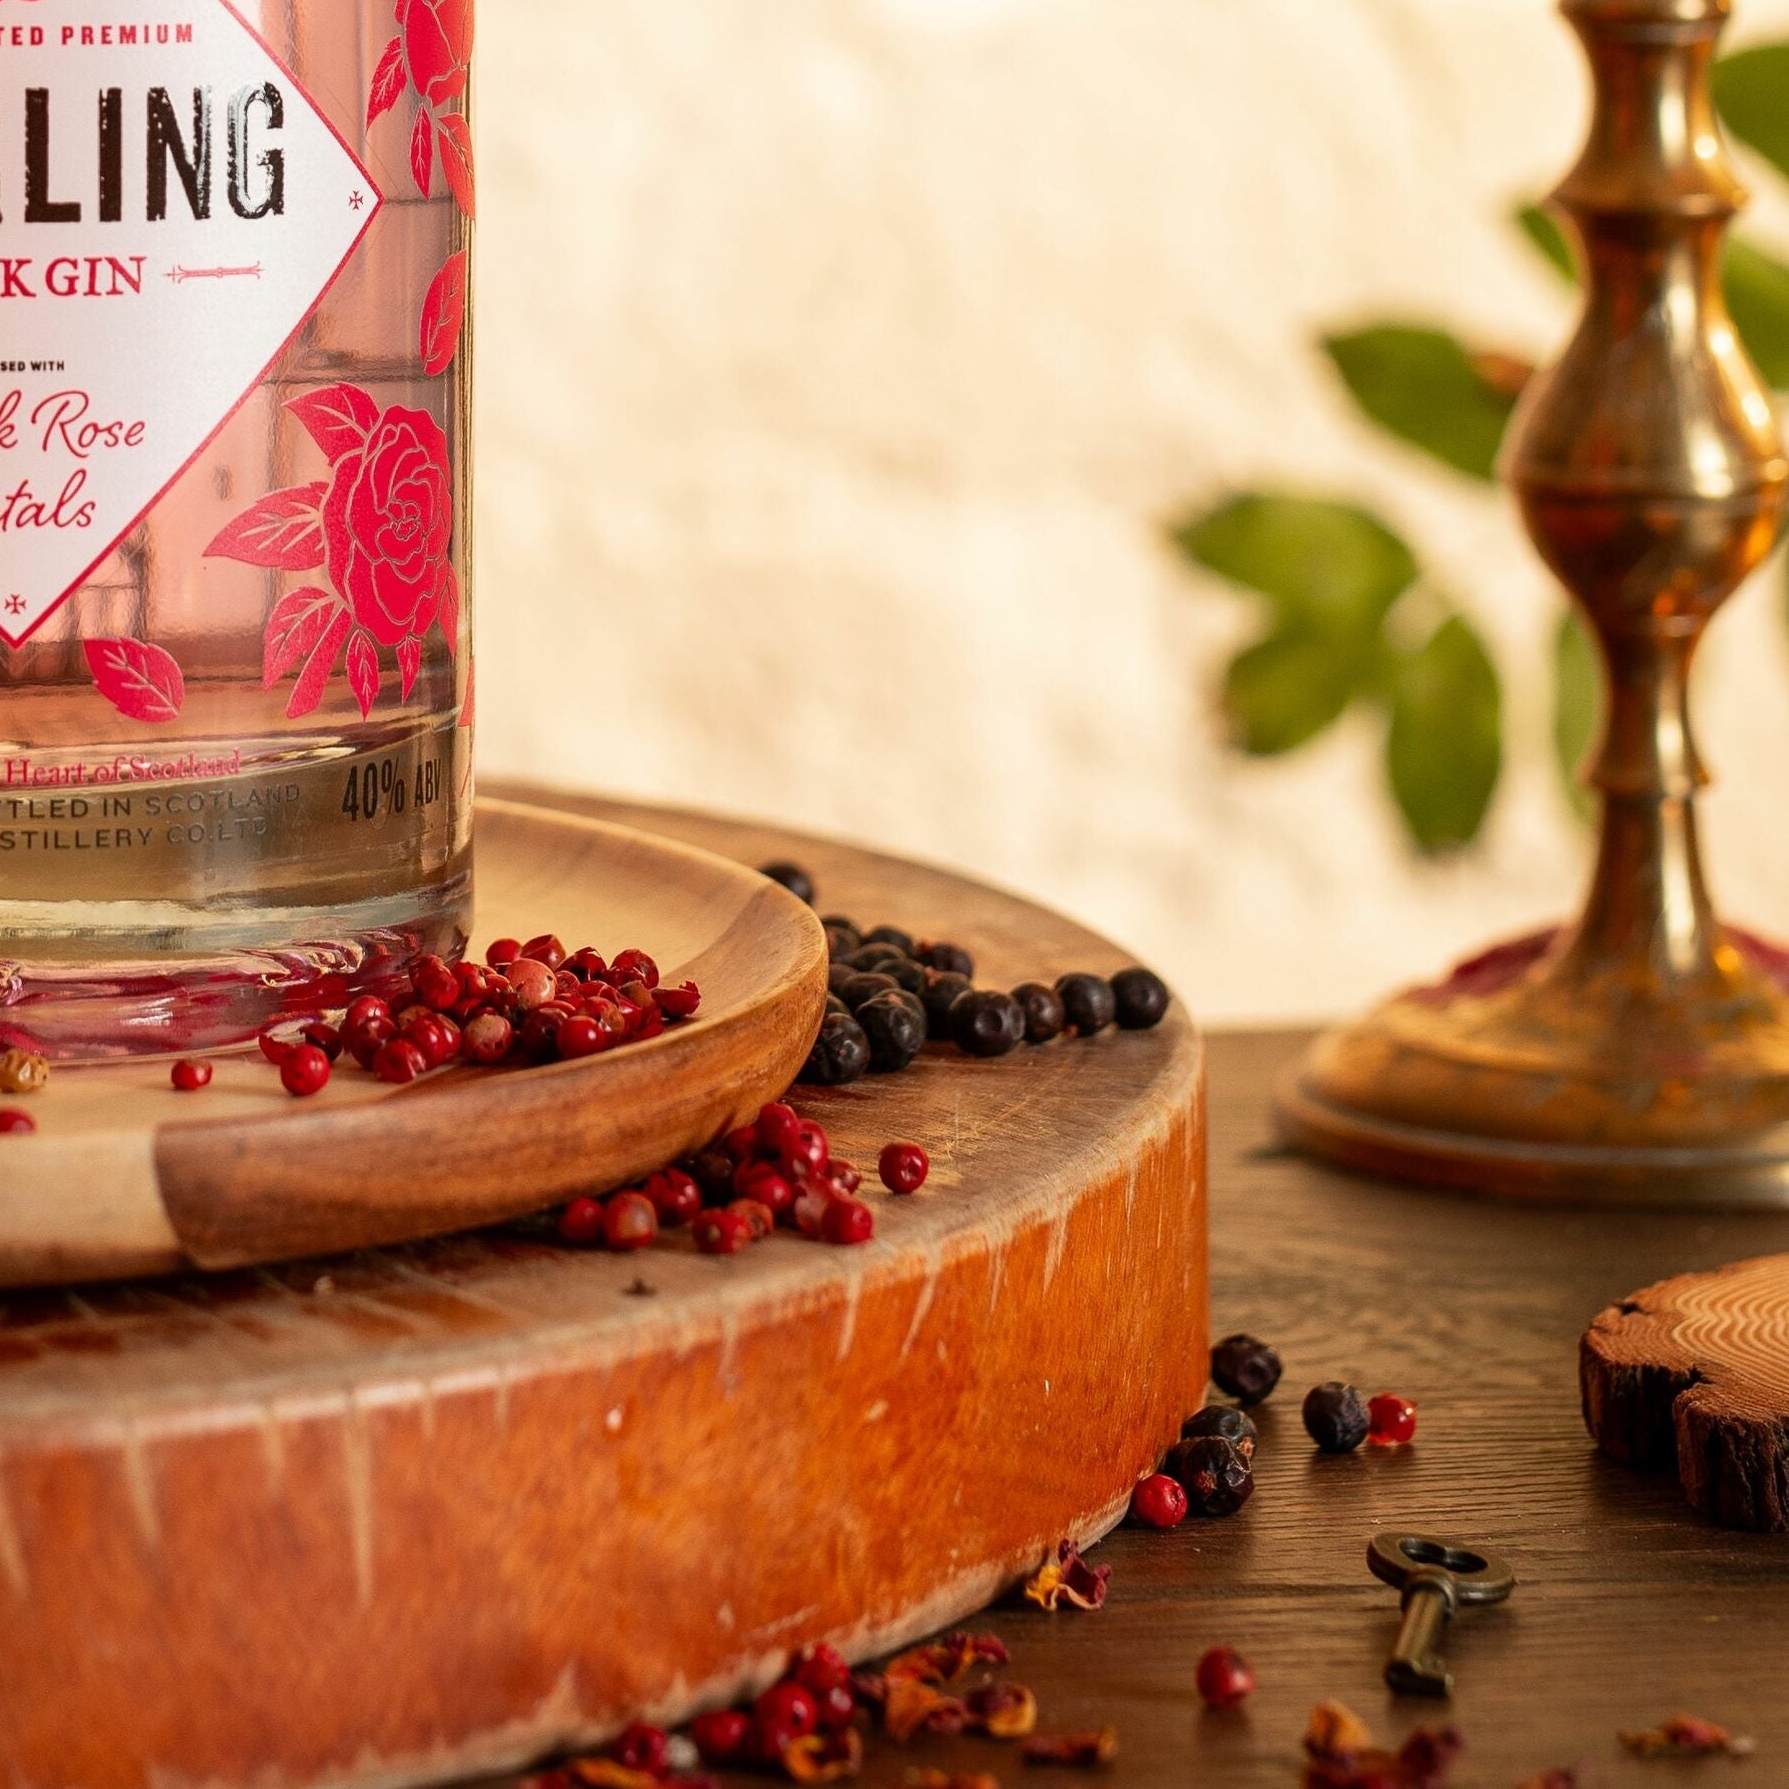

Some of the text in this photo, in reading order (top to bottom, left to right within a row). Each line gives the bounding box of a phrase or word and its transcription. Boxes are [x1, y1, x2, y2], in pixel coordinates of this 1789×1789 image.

[61, 23, 193, 45] PREMIUM
[45, 256, 147, 296] GIN
[31, 361, 65, 371] WITH
[31, 389, 145, 458] Rose
[5, 758, 85, 787] Heart
[94, 754, 126, 783] of
[129, 747, 241, 780] Scotland
[103, 797, 131, 816] IN
[146, 782, 300, 816] SCOTLAND
[342, 757, 442, 822] 40% ABV
